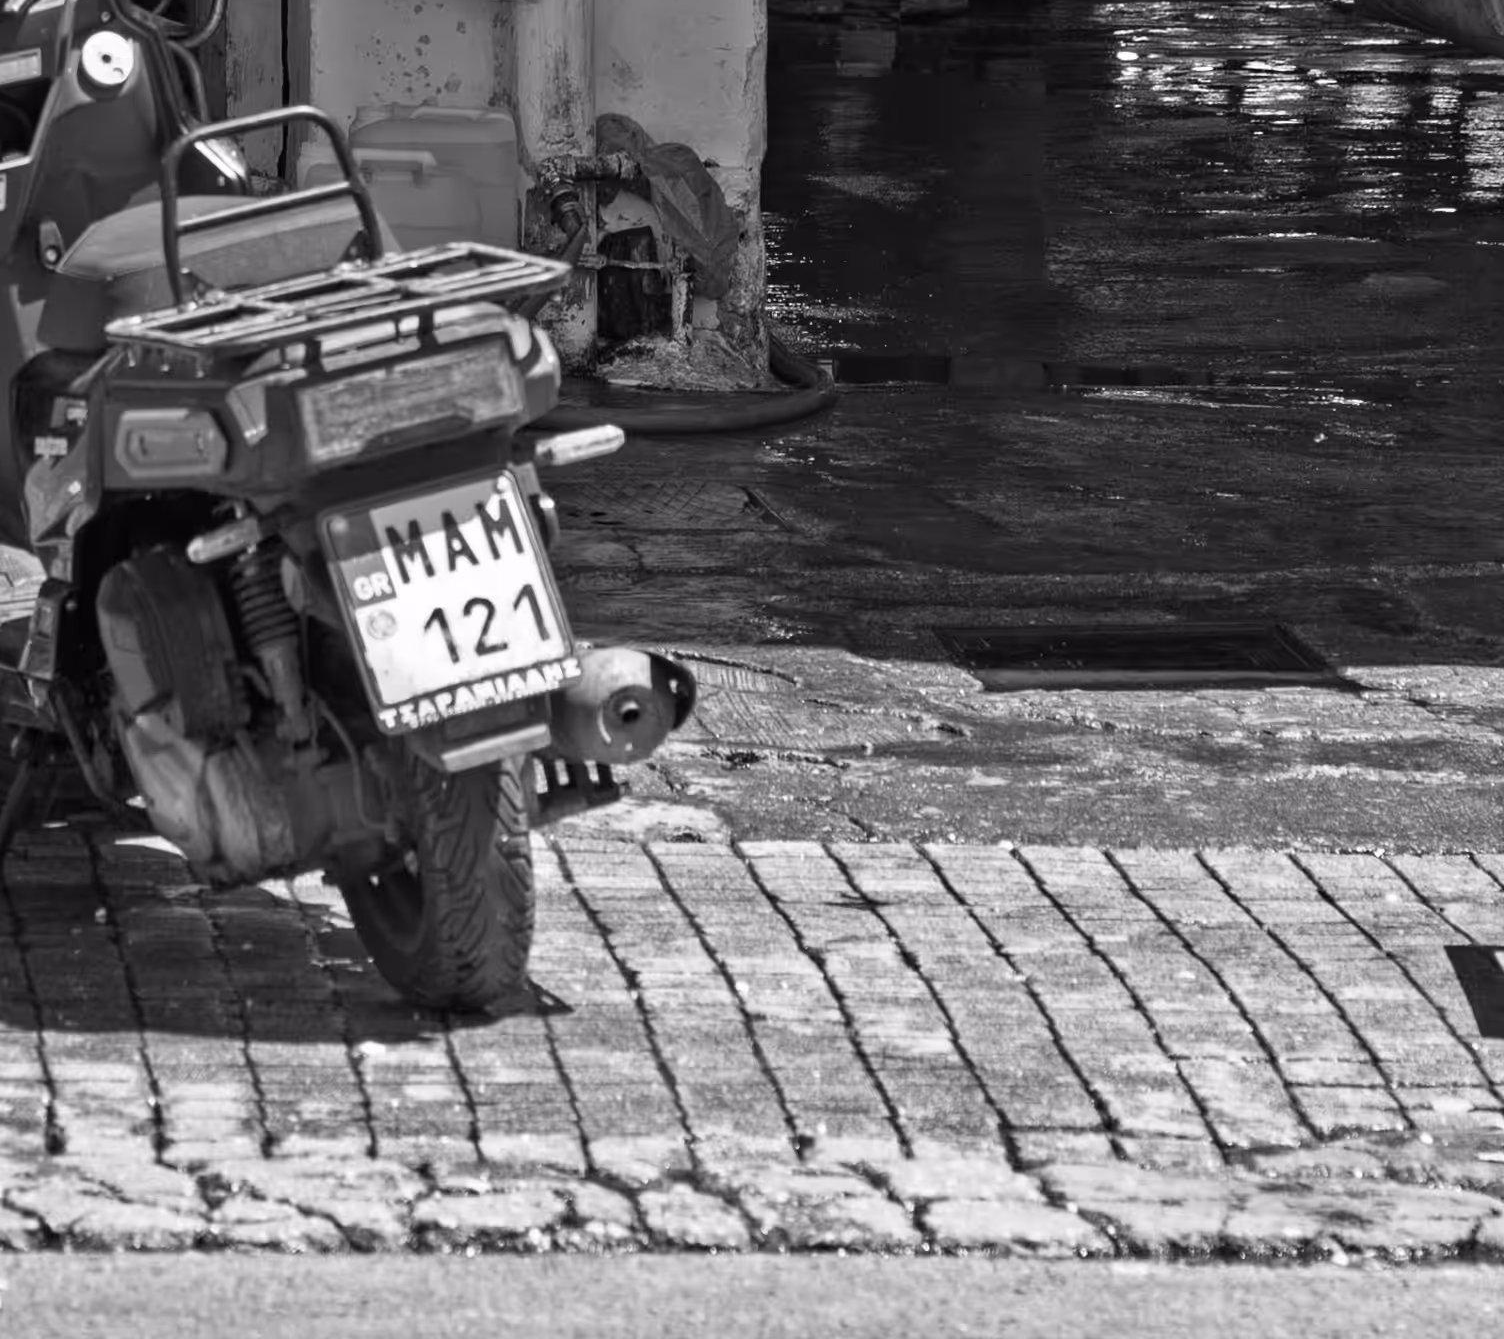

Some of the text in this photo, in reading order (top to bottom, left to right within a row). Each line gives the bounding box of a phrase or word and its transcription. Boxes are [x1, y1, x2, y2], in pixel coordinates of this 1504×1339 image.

[386, 498, 524, 584] MAM
[353, 571, 392, 601] GR
[423, 584, 550, 664] 121
[377, 657, 582, 729] ΤΣΑΡΑΜΙΑΔΗΣ
